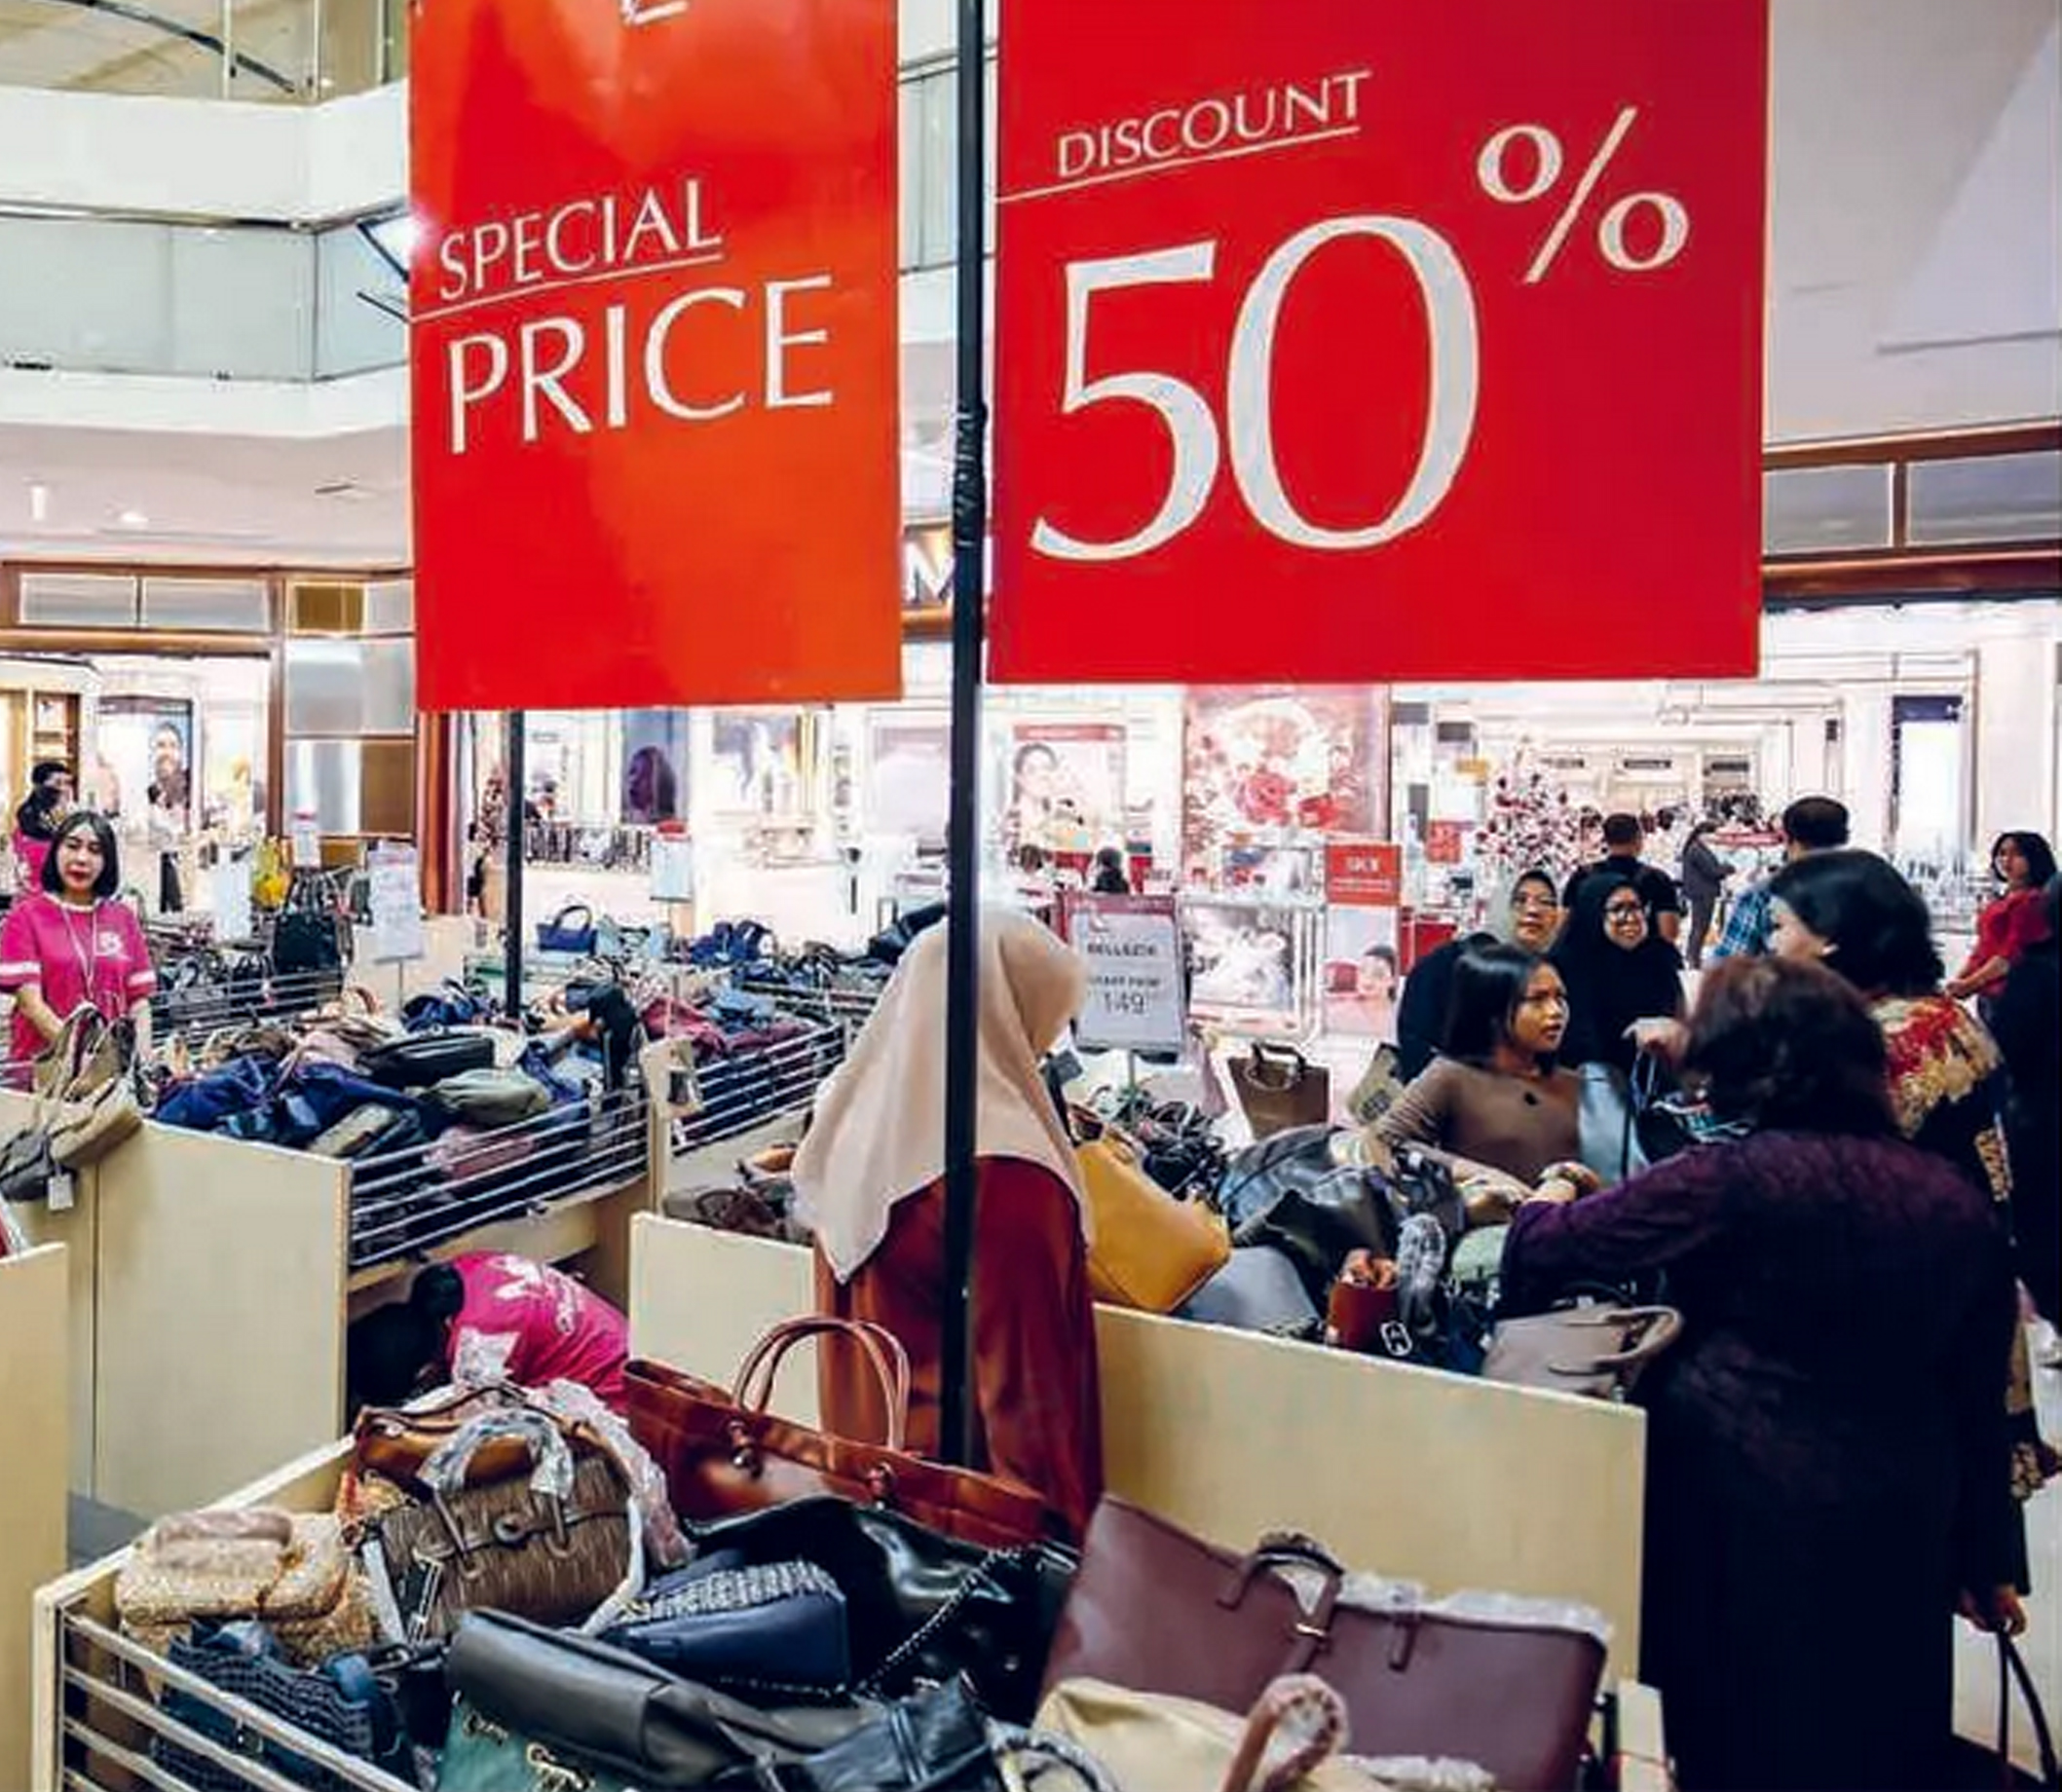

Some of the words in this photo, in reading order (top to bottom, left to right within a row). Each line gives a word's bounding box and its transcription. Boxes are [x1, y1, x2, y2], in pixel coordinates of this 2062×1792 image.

[1057, 71, 1371, 178] DISCOUNT
[440, 179, 722, 302] SPECIAL
[449, 275, 833, 454] PRICE
